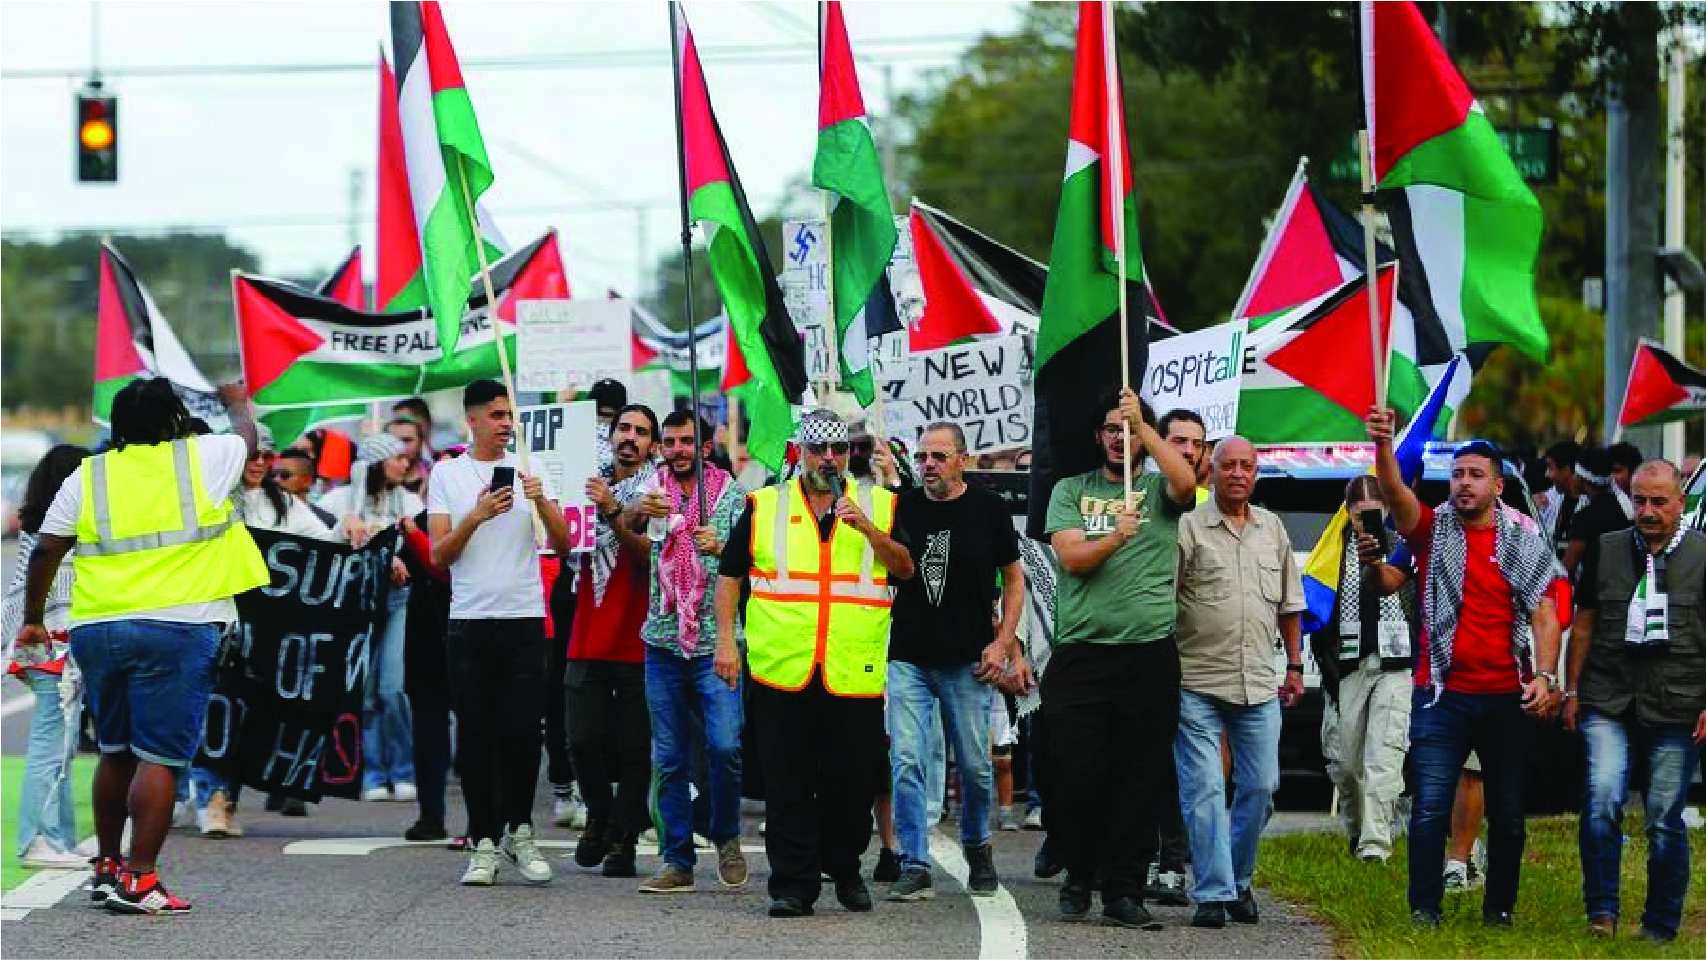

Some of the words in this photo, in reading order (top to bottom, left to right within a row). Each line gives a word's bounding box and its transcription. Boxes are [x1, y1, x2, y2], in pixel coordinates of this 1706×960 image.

[332, 330, 388, 353] FREE
[925, 345, 1004, 386] NEW
[912, 384, 1022, 420] WORLD
[915, 413, 1029, 450] ZIS
[276, 632, 334, 701] OF
